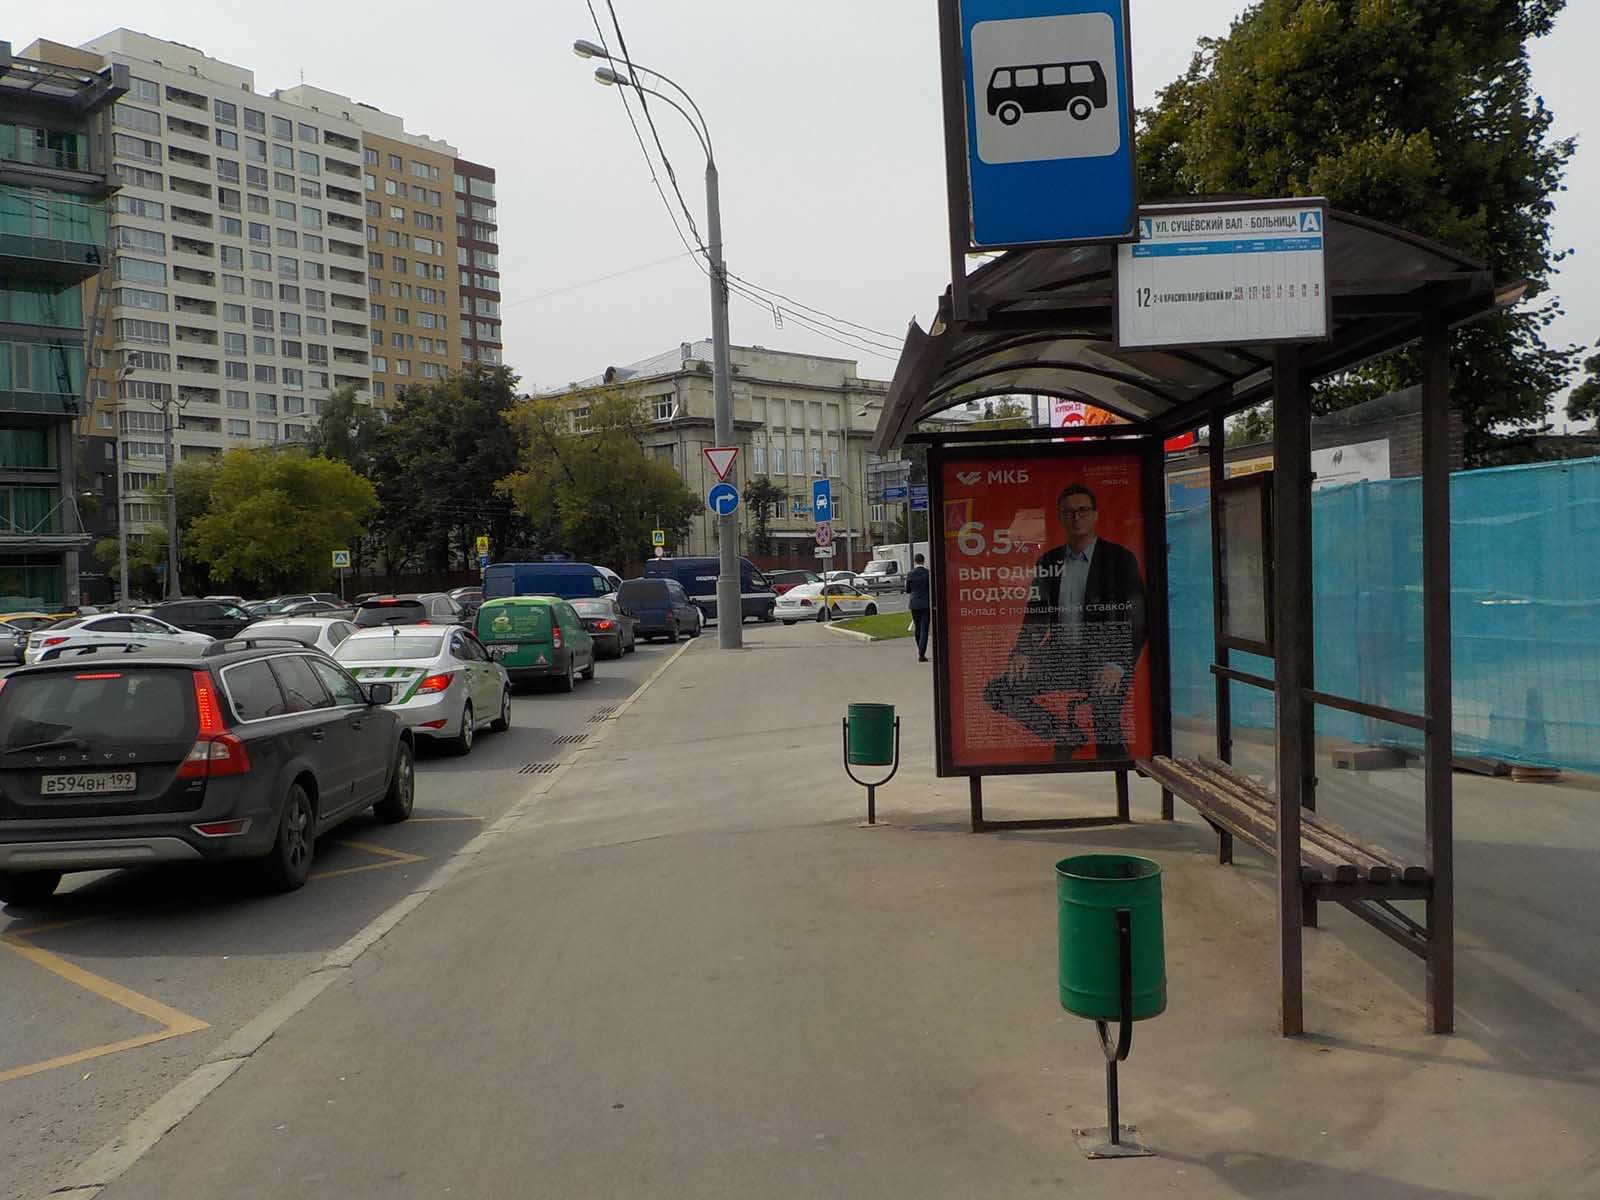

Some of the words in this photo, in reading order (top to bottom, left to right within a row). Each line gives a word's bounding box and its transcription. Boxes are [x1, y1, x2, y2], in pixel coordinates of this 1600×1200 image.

[1155, 220, 1169, 233] УЛ.
[1170, 215, 1223, 233] СУЩЁВСКИЙ
[1225, 218, 1243, 229] ВАЛ
[1250, 215, 1297, 228] БОЛЬНИЦА
[1302, 213, 1320, 232] А
[1136, 287, 1151, 307] 12
[986, 469, 1030, 486] МКБ
[959, 560, 1066, 581] ВЫГОДНЫЙ
[959, 586, 1041, 604] ПОДХОД
[960, 607, 996, 617] Вклад
[998, 607, 1007, 615] с
[1086, 601, 1133, 612] ставкой
[35, 752, 137, 762] VOLVO
[109, 774, 132, 785] 199
